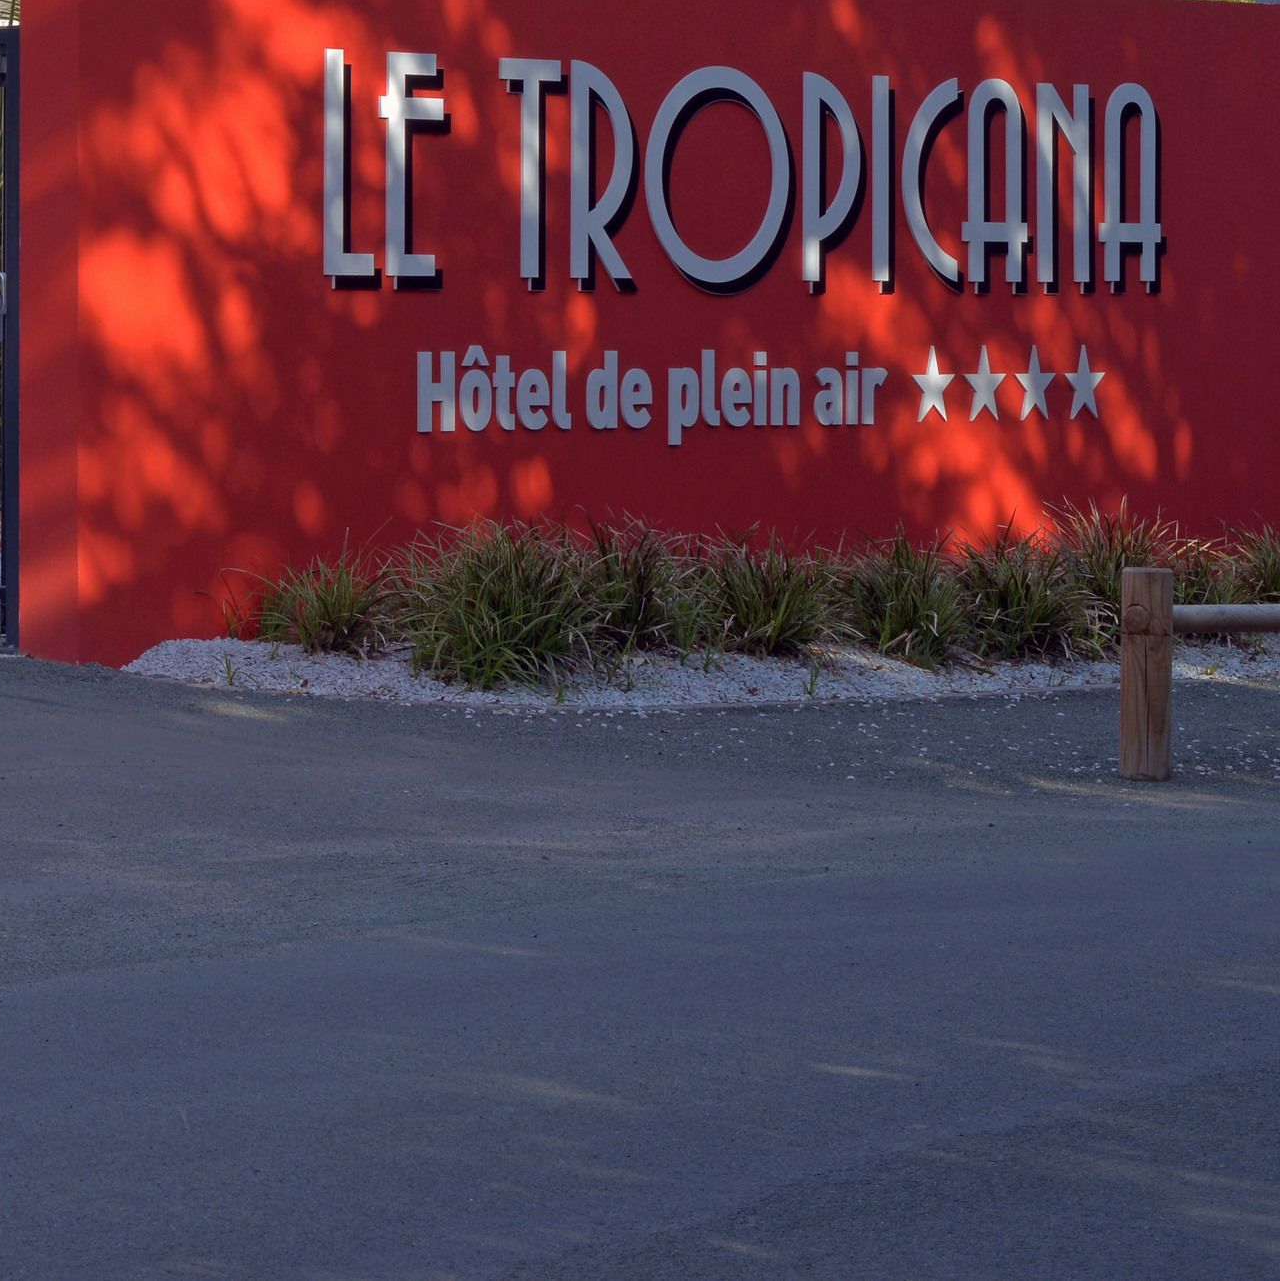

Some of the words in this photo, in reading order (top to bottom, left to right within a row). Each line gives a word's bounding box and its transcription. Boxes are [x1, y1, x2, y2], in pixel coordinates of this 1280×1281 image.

[324, 49, 447, 281] LE
[499, 56, 1163, 287] TROPICANA
[417, 345, 572, 433] Hôtel
[586, 350, 653, 429] de
[668, 349, 801, 446] plein
[813, 351, 889, 426] air
